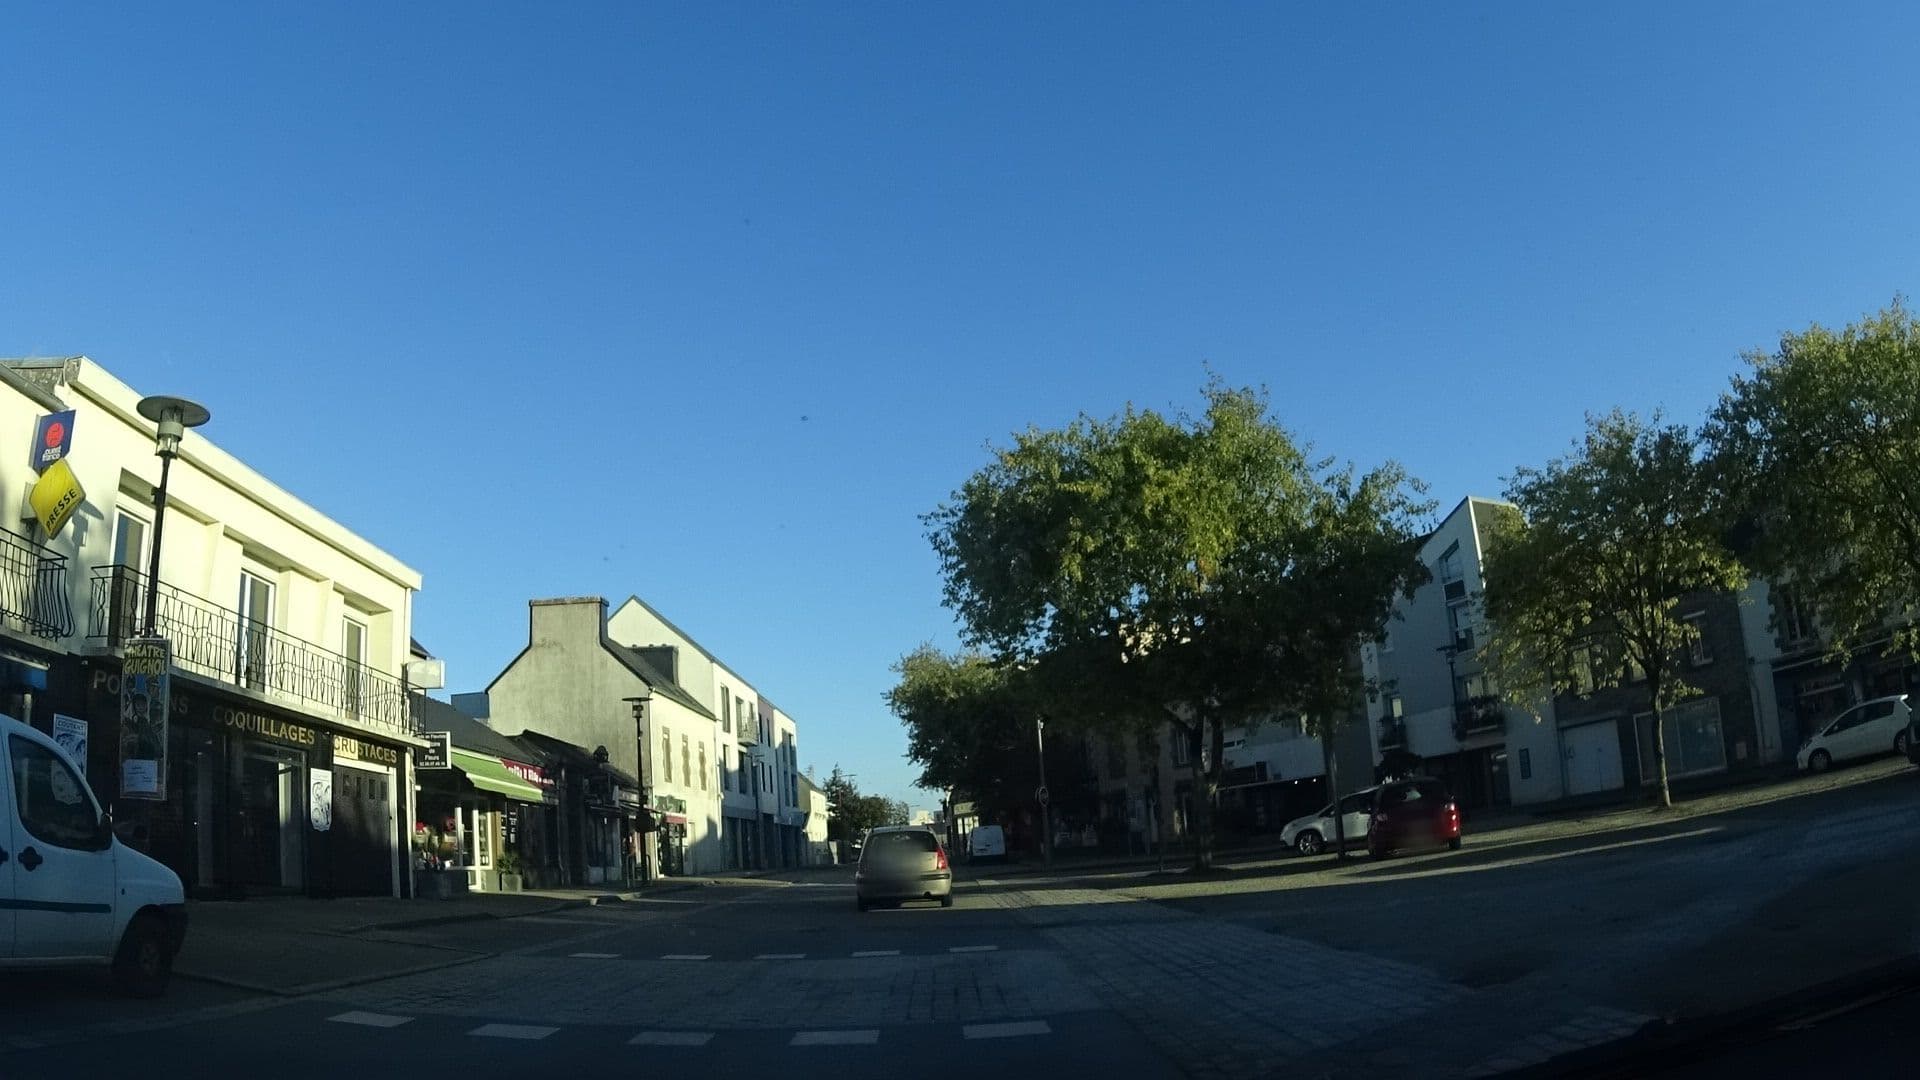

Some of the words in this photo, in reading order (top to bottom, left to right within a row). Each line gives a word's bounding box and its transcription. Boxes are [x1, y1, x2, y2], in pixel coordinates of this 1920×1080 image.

[45, 488, 78, 532] PRESSE
[124, 658, 167, 675] GUIGNOL
[213, 705, 316, 746] COQUILLAGES
